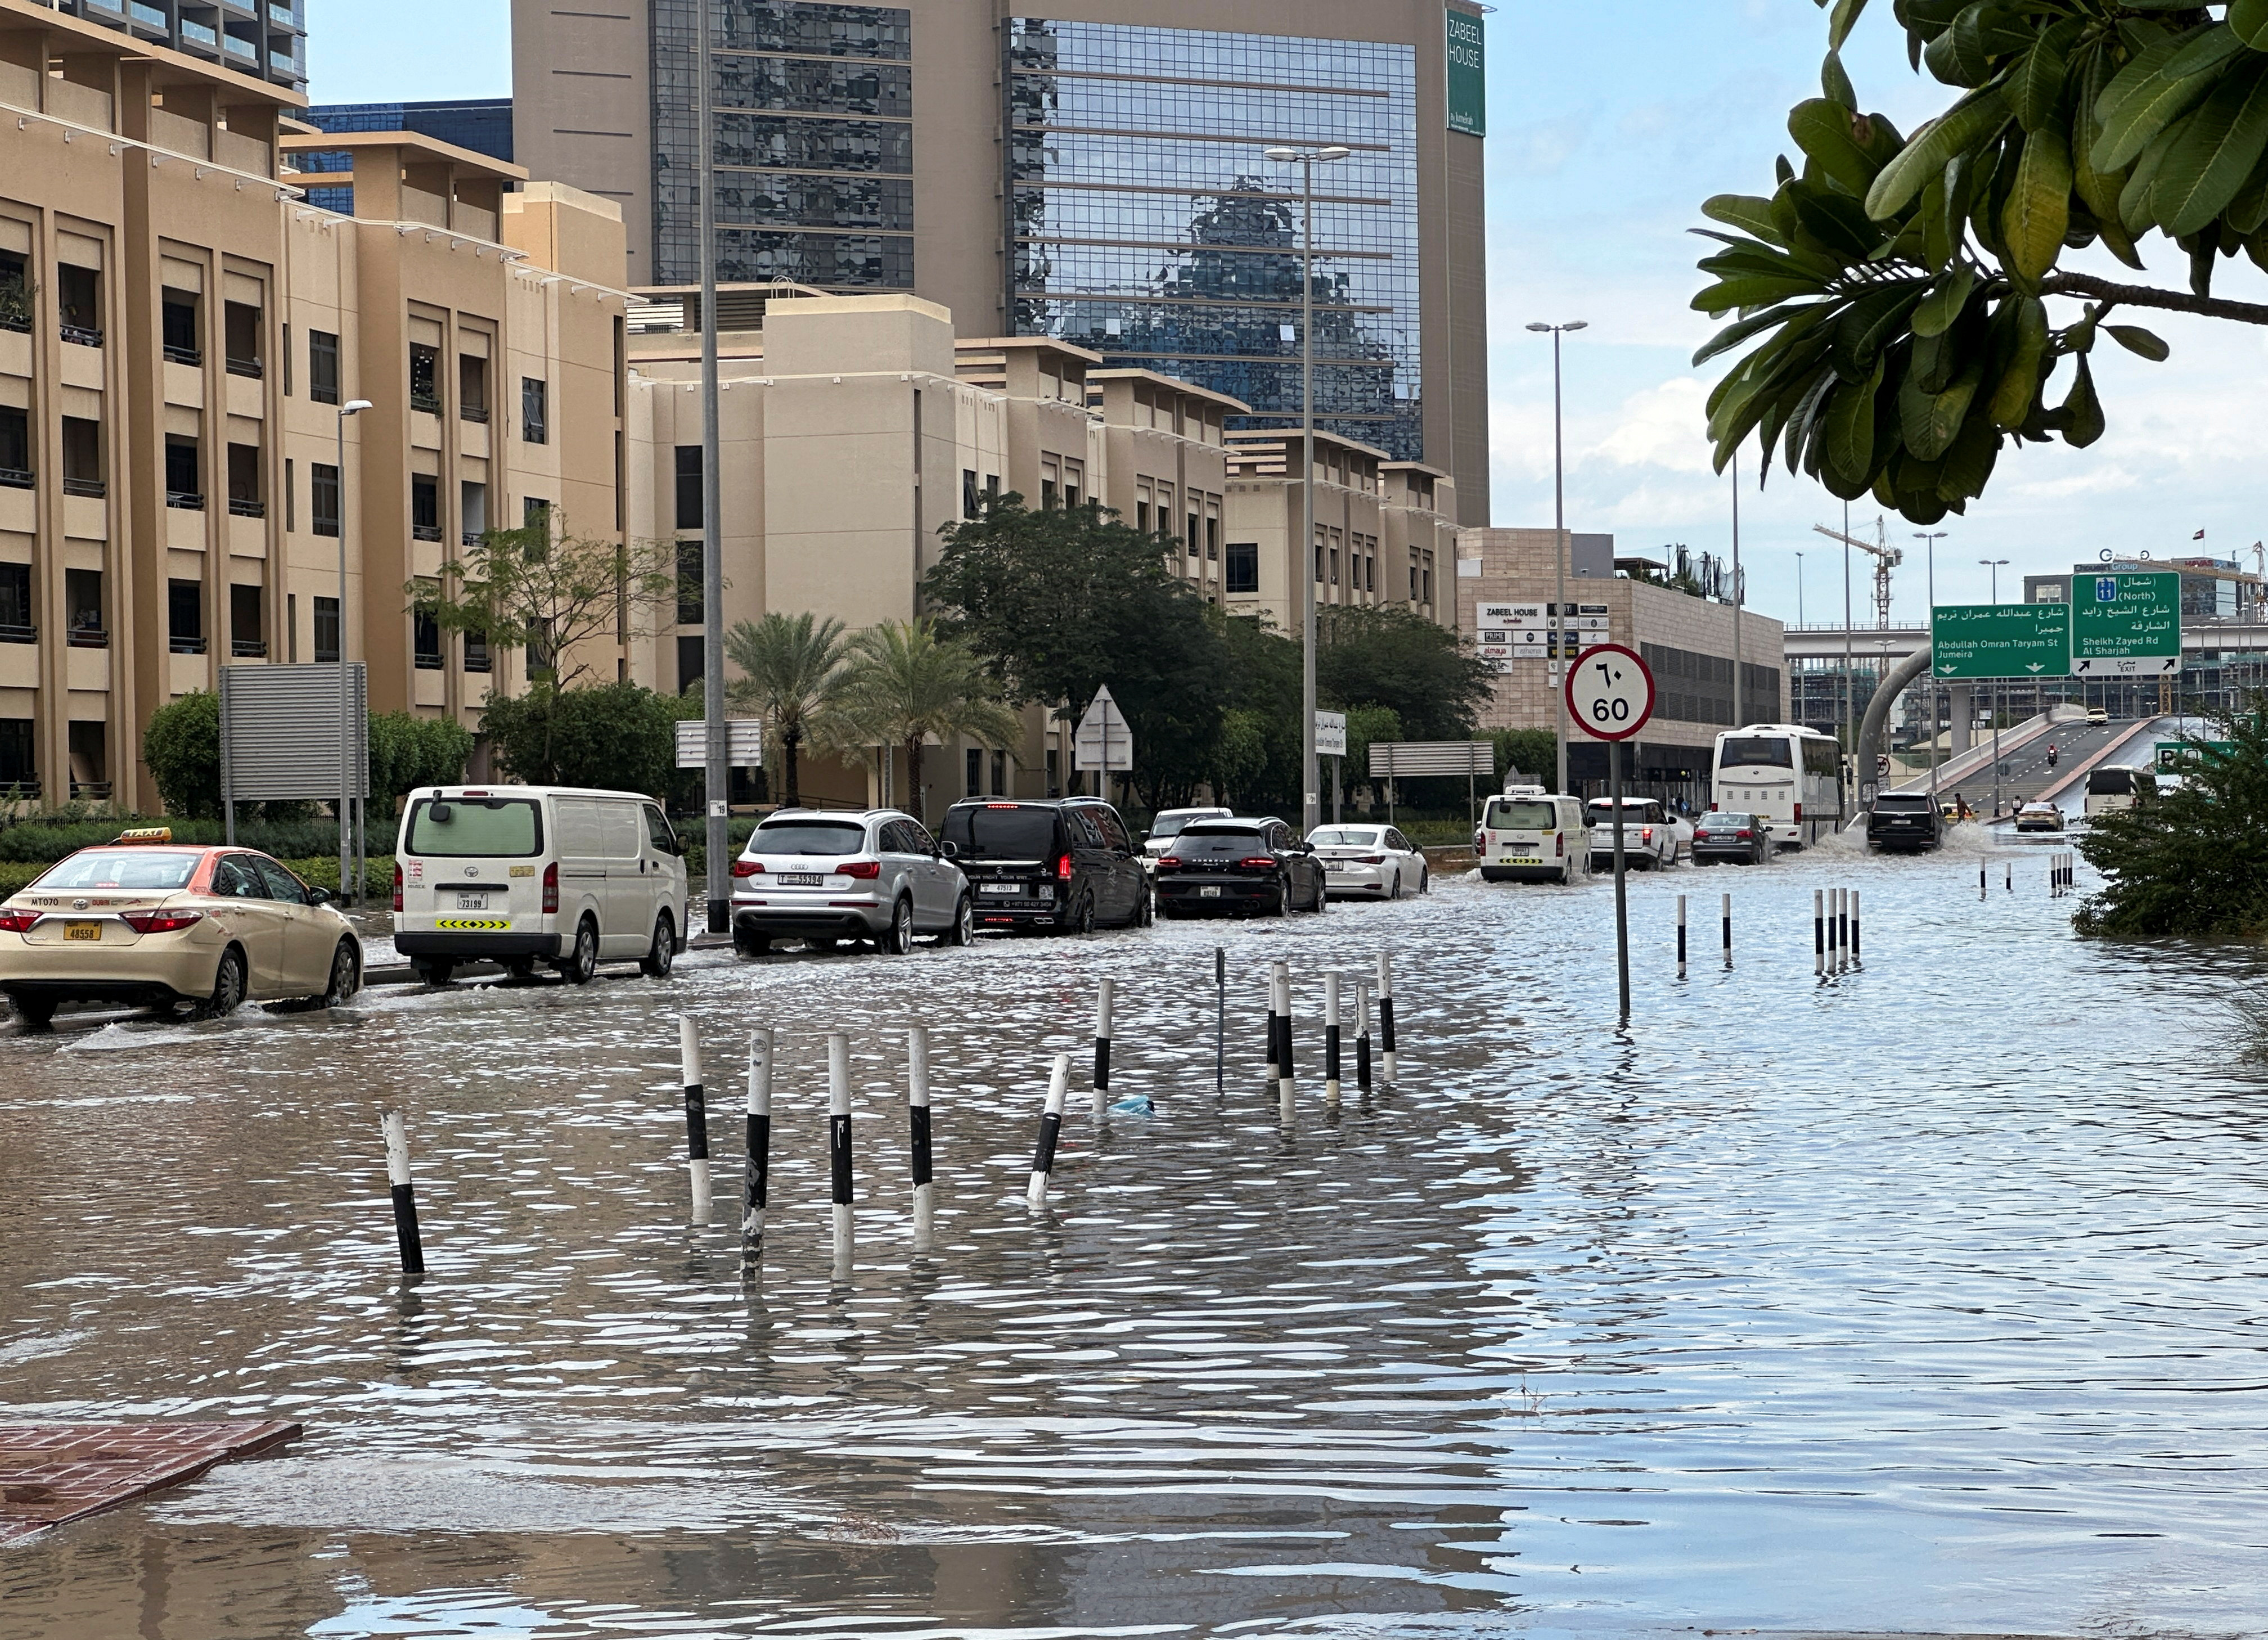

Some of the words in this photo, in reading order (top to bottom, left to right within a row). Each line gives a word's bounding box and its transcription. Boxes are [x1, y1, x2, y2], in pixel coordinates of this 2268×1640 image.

[1449, 19, 1482, 45] ZABEEL
[1449, 45, 1480, 69] HOUSE
[2112, 562, 2138, 571] Group
[2100, 589, 2111, 599] 11
[2118, 592, 2156, 602] (North)
[1487, 608, 1513, 616] ZABEEL
[1937, 610, 1957, 621] تريم
[1961, 609, 1991, 621] عمران
[1996, 608, 2032, 619] عبدالله
[2038, 607, 2064, 619] شارع
[2082, 606, 2102, 617] زايد
[2107, 606, 2137, 618] الشيخ
[2143, 605, 2170, 617] شارع
[2035, 624, 2063, 634] جميرا
[2131, 620, 2170, 632] الشارقة
[1938, 640, 1978, 649] Abdullah
[1981, 639, 2010, 648] Omran
[2013, 639, 2045, 649] Taryam
[2048, 638, 2058, 647] St
[2116, 637, 2143, 646] Zayed
[1484, 646, 1507, 656] almaya
[2096, 647, 2130, 656] Sharjah
[1592, 697, 1629, 722] 60
[798, 875, 821, 884] 55394
[31, 898, 58, 907] MT070
[461, 899, 482, 908] 73199
[70, 929, 94, 939] 48558
